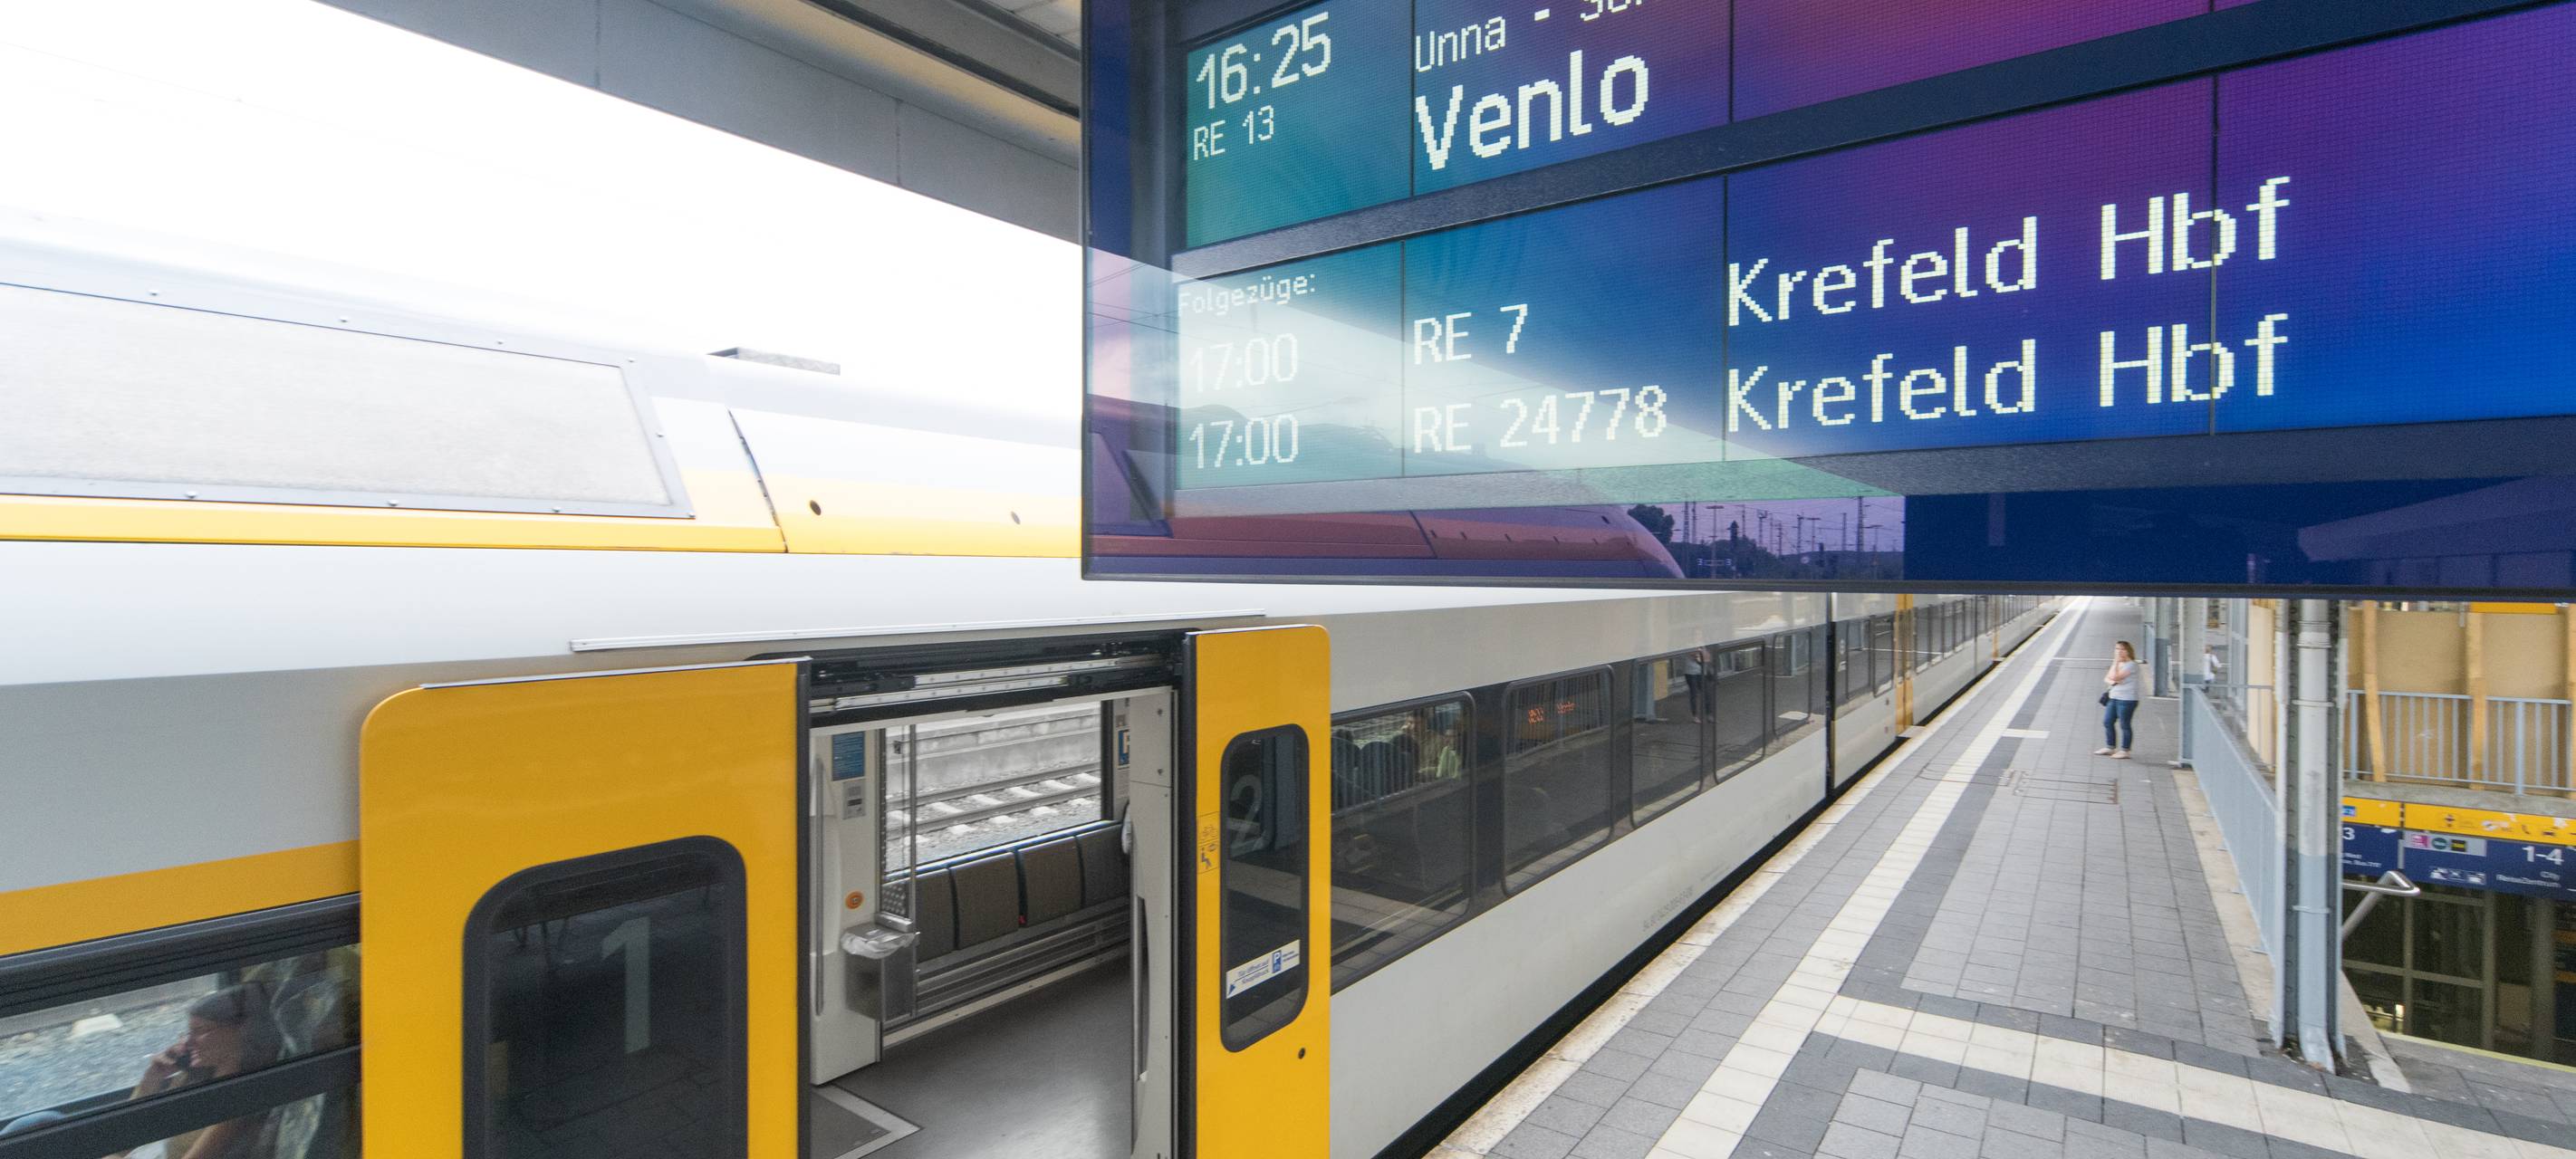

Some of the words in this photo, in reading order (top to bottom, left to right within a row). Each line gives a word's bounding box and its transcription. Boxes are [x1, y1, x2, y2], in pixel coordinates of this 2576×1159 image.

[1196, 12, 1331, 110] 16:25
[1415, 14, 1507, 72] Unna
[1193, 120, 1226, 161] RE
[1242, 106, 1274, 146] 13
[1415, 49, 1649, 170] Venlo
[1728, 216, 2037, 326] Krefeld
[2100, 177, 2290, 281] Hbf
[1177, 274, 1315, 317] Folgezüge:
[1188, 332, 1299, 393] 17:00
[1414, 311, 1472, 364] RE
[1500, 303, 1528, 353] 7
[1727, 339, 2036, 433] Krefeld
[2099, 313, 2289, 407] Hbf
[1188, 414, 1299, 469] 17:00
[1414, 402, 1472, 454] RE
[1499, 385, 1668, 447] 24778
[1230, 773, 1265, 857] 2
[2522, 845, 2564, 866] 1-4
[601, 915, 651, 1055] 1
